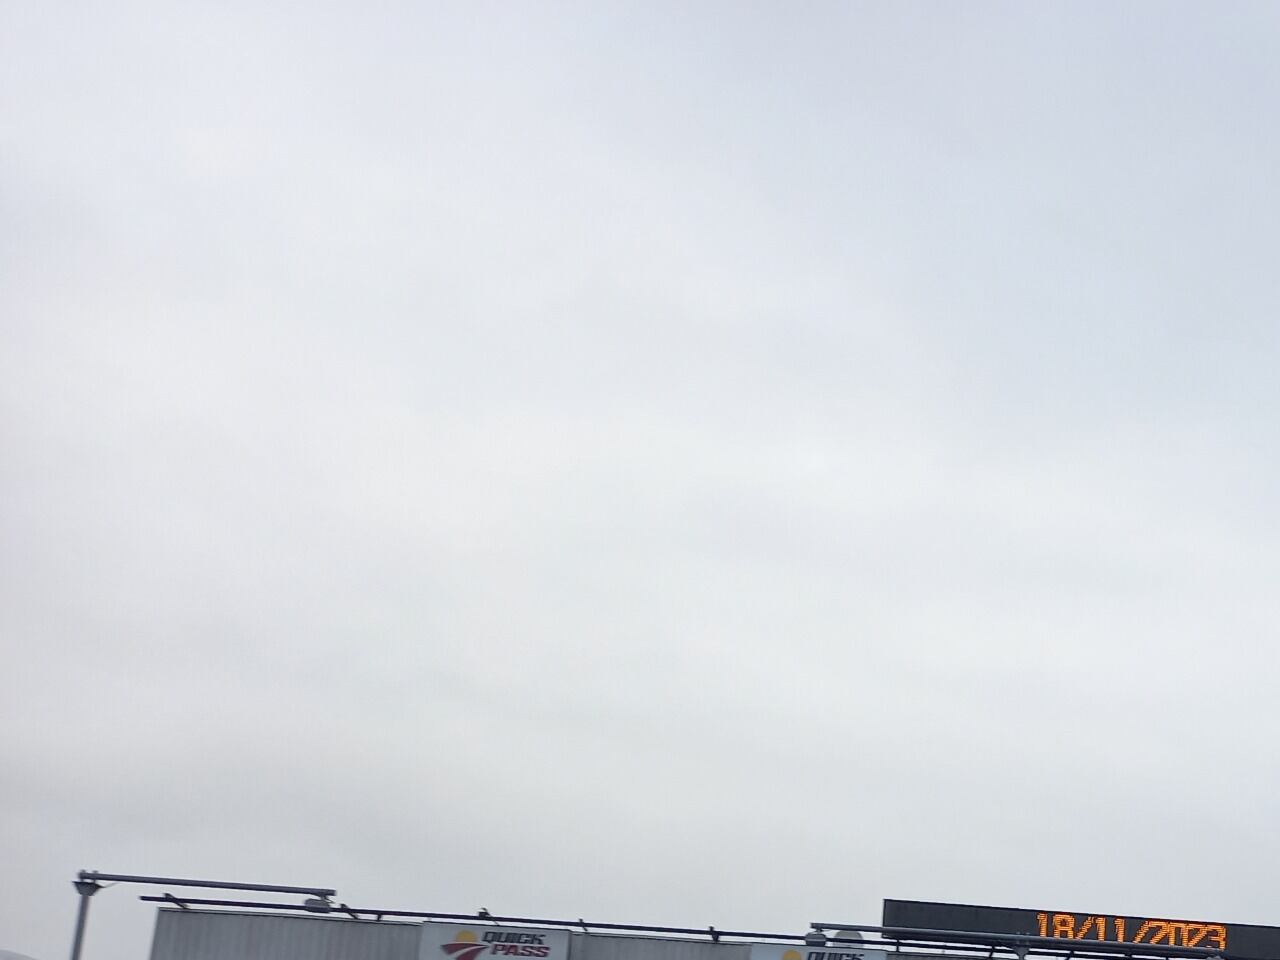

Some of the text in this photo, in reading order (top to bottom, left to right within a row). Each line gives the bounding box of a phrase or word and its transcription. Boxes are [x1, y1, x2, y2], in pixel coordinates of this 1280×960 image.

[482, 931, 547, 945] QUICK
[1036, 911, 1227, 951] 18/11/2023
[490, 943, 550, 958] PASS
